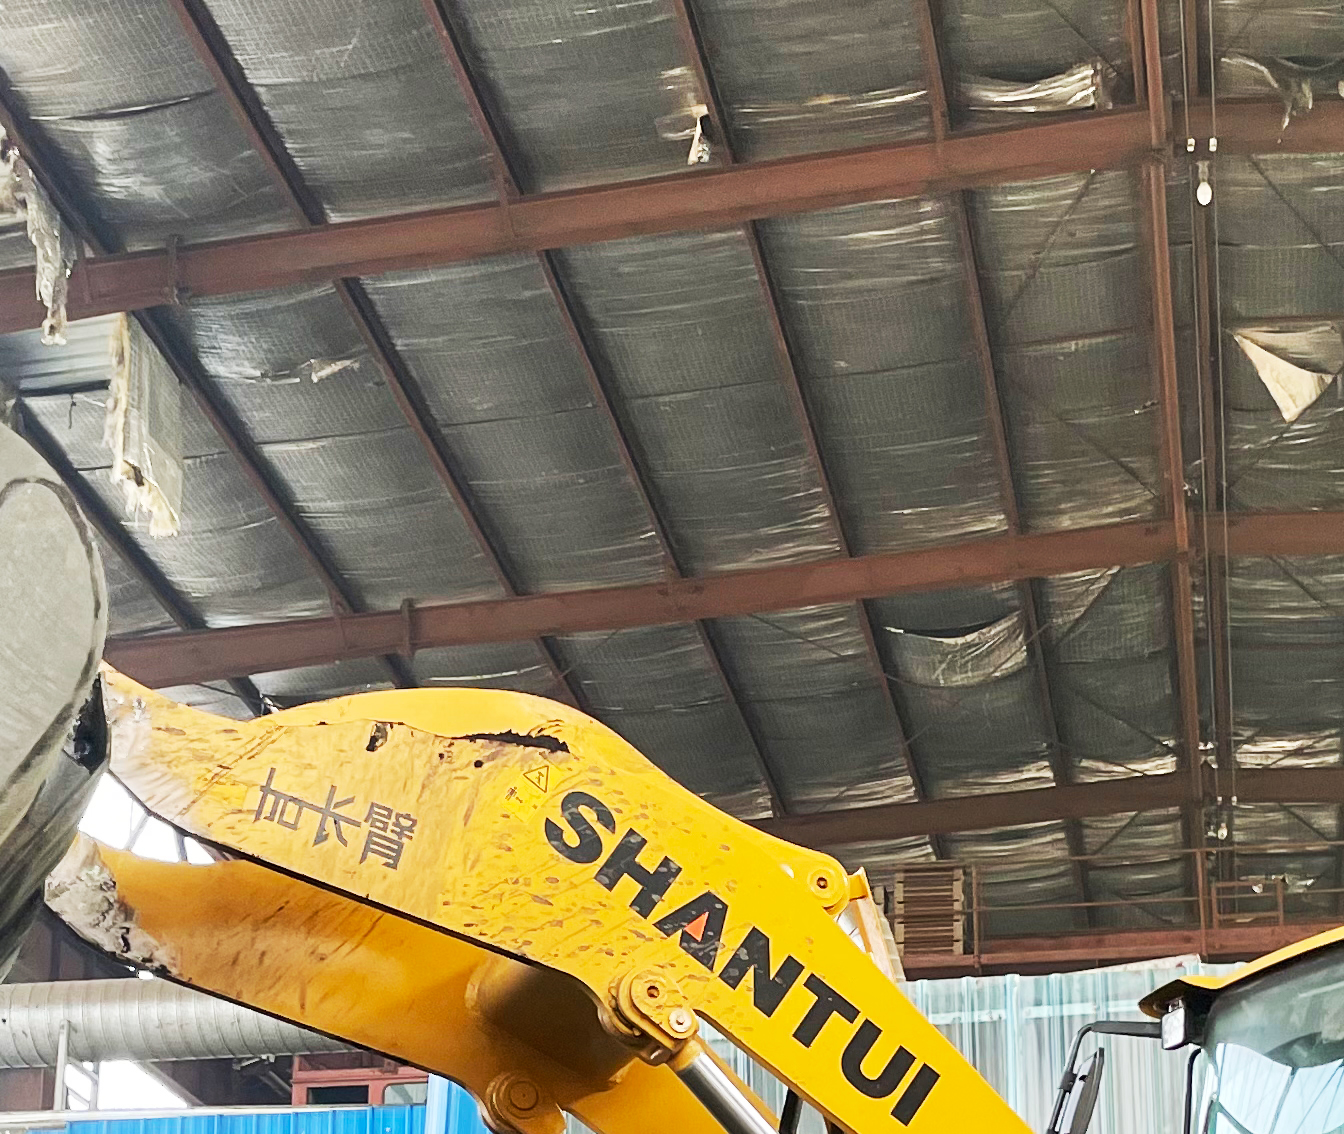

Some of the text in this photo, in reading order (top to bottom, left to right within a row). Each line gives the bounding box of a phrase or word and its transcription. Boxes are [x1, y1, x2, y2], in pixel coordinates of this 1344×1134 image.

[253, 767, 418, 870] 加长臂
[544, 791, 941, 1127] SHANTUI
